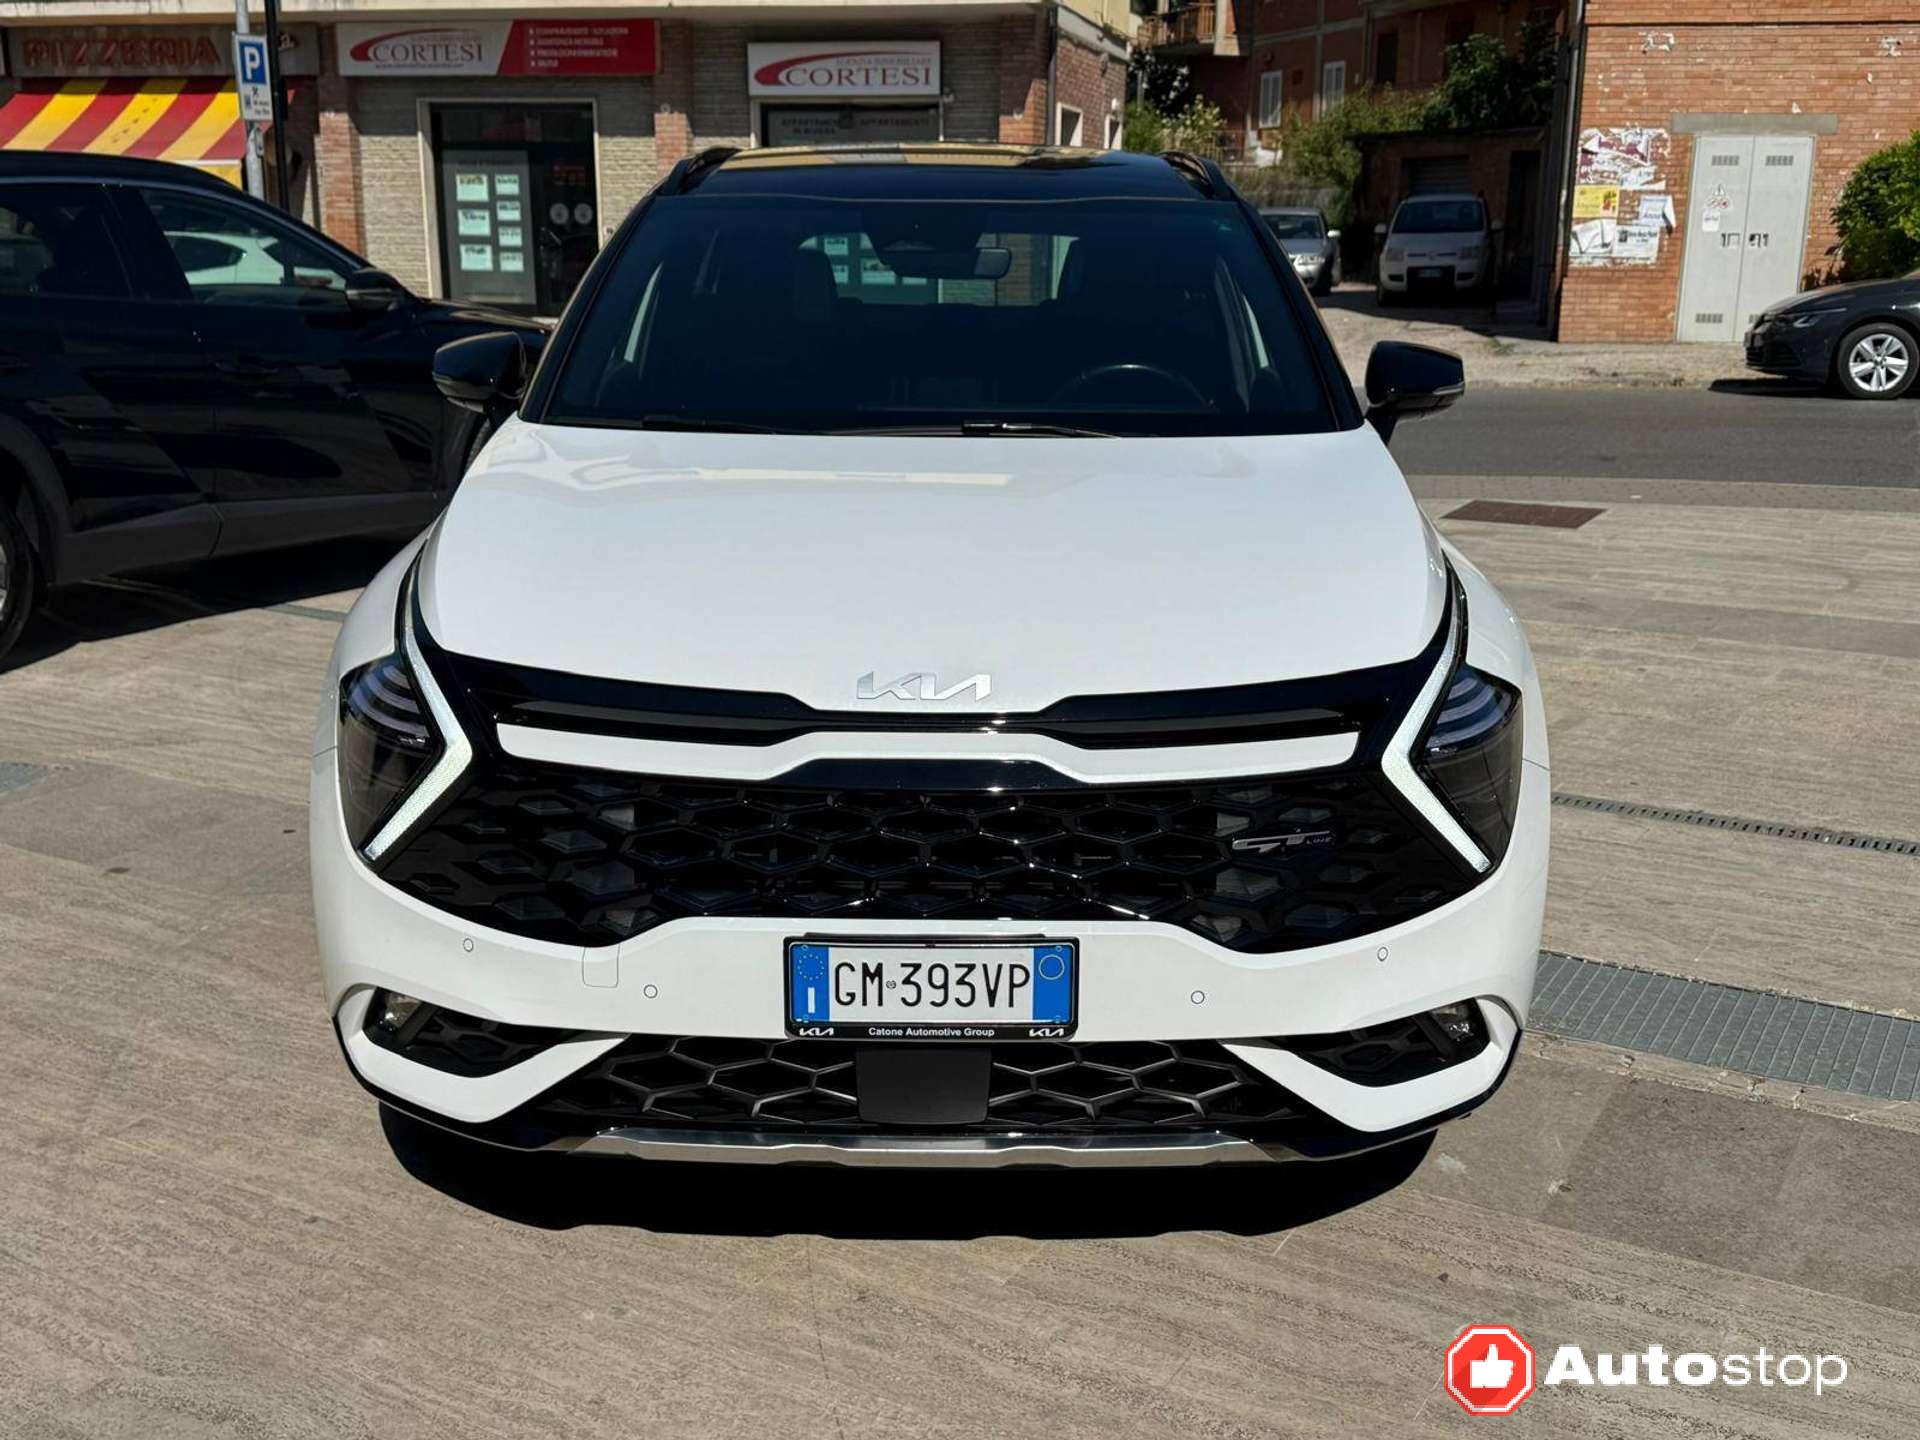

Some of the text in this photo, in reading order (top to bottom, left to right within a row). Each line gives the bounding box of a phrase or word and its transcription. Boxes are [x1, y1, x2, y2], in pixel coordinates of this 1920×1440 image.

[23, 37, 222, 66] PIZZERIA
[373, 43, 483, 62] CORTESI
[244, 47, 260, 80] P
[786, 66, 931, 86] CORTESI
[857, 671, 992, 702] KIA
[799, 1026, 835, 1037] KIA
[868, 1027, 995, 1039] Catone Automotive Group
[1028, 1027, 1064, 1038] KIA
